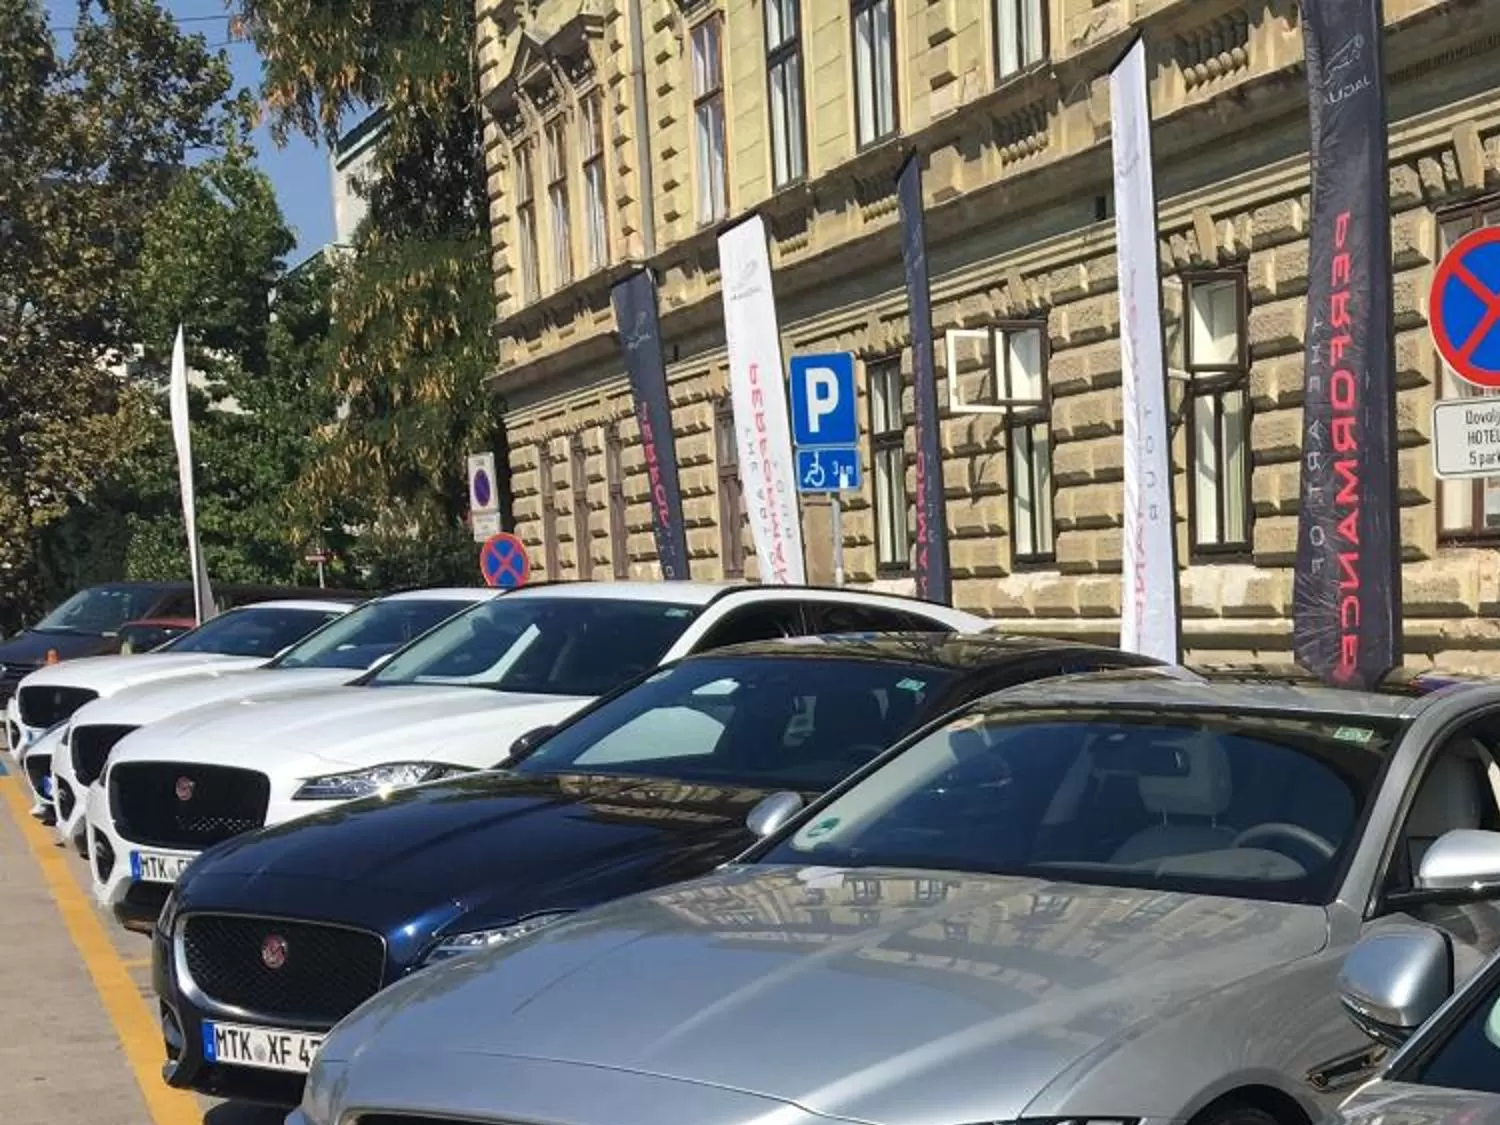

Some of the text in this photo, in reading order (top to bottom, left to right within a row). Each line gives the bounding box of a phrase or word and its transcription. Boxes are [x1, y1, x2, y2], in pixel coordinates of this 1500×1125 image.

[805, 366, 840, 433] P
[1469, 450, 1477, 465] 5
[215, 1027, 253, 1061] MTK
[267, 1034, 292, 1066] XF
